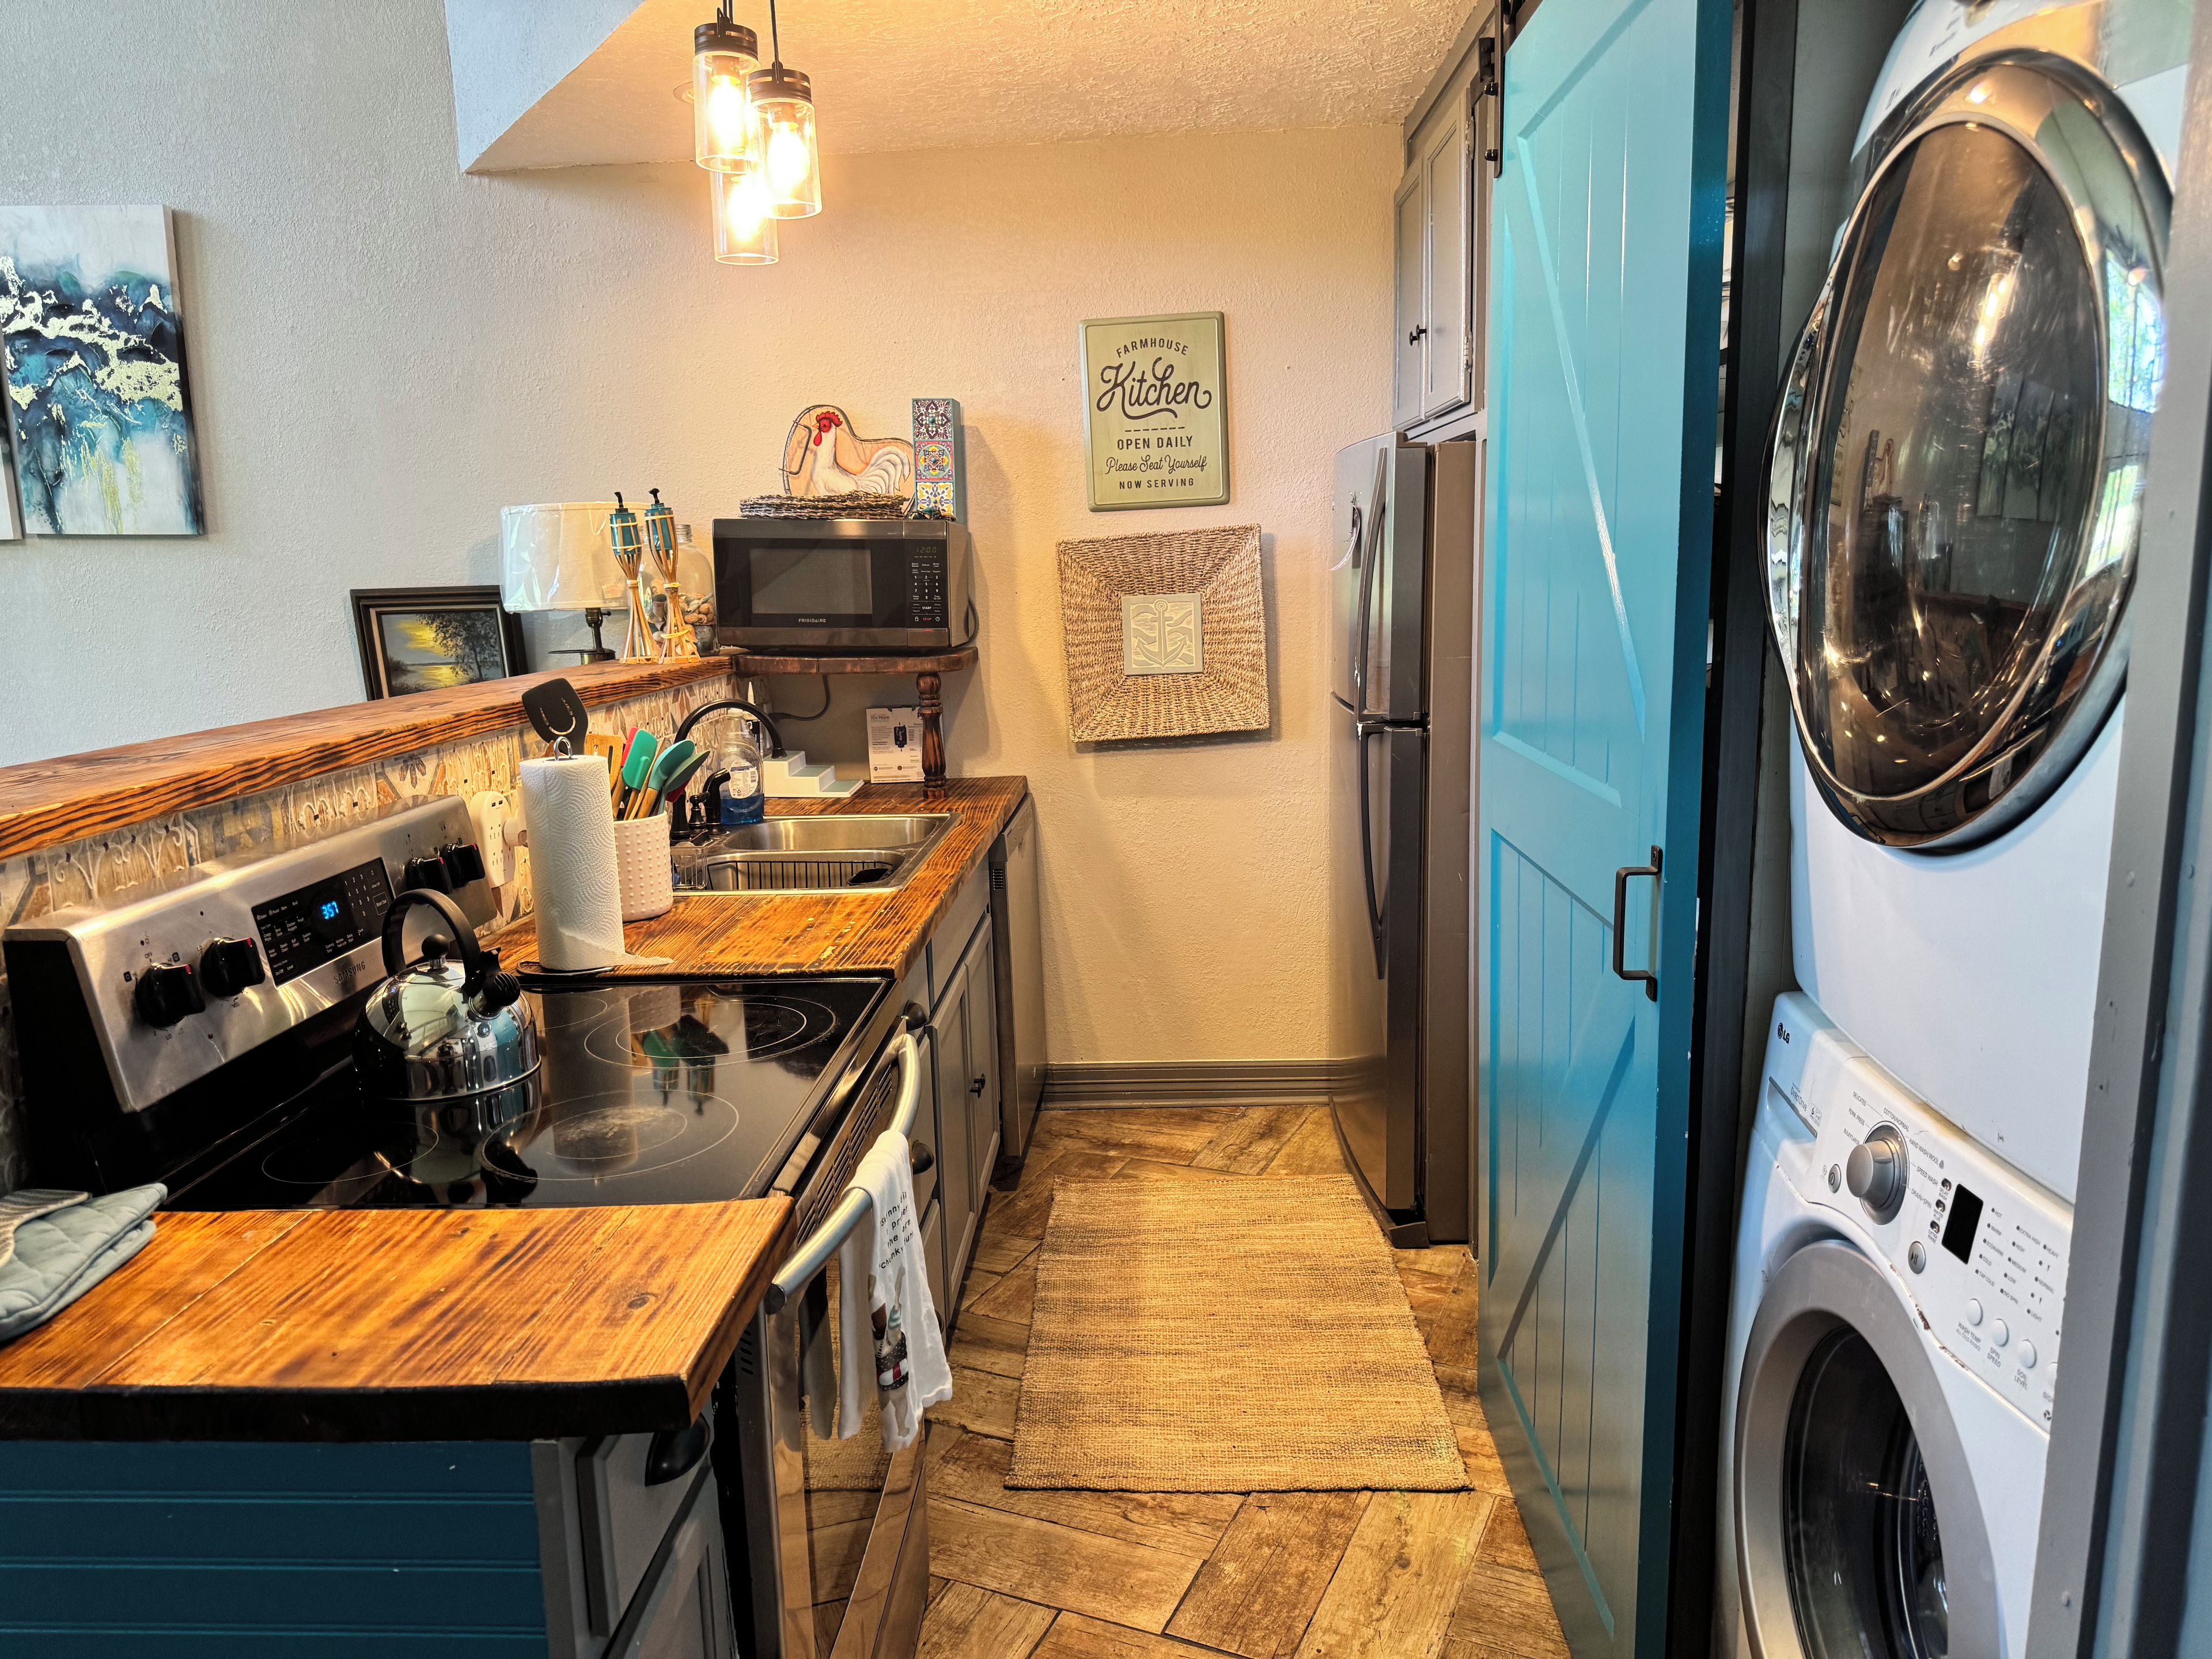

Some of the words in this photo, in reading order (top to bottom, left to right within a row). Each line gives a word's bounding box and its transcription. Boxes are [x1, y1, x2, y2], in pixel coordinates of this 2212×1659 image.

[1116, 338, 1188, 358] FARMHOUSE
[1096, 357, 1212, 420] Kitchen
[1118, 438, 1150, 450] OPEN
[1157, 435, 1193, 448] DAILY
[1105, 457, 1138, 474] Please
[1139, 454, 1162, 472] Seat
[1164, 455, 1207, 474] Yourself
[1119, 480, 1141, 489] NOW
[1147, 478, 1194, 488] SERVING
[334, 961, 366, 984] SAMSUNG
[1783, 1029, 1790, 1044] LG
